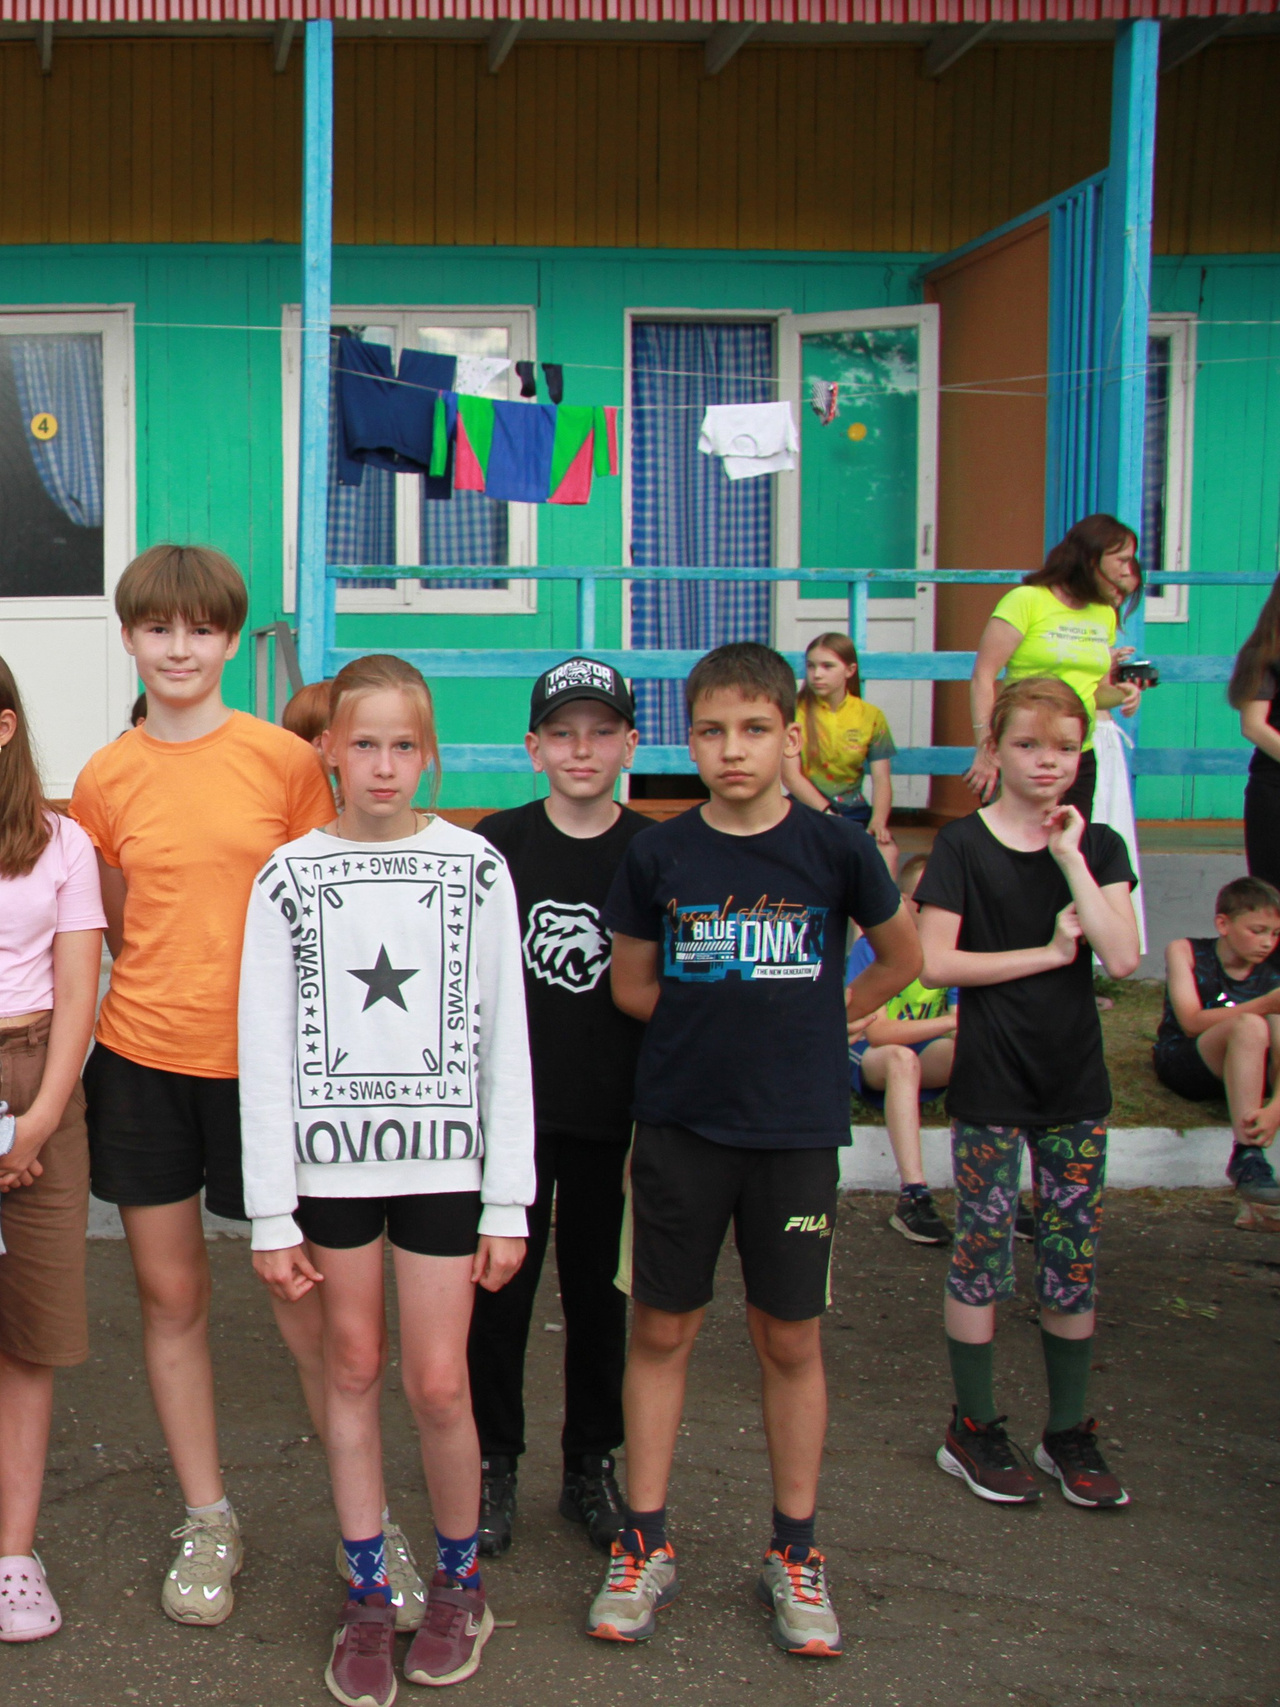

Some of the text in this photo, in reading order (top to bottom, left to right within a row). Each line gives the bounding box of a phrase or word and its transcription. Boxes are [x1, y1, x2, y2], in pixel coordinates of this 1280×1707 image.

[37, 418, 49, 433] 4
[548, 676, 612, 695] HOCKEY
[370, 857, 417, 875] SWAG
[736, 894, 811, 934] Active
[693, 921, 736, 941] BLUE
[300, 926, 320, 999] SWAG
[756, 967, 812, 976] THE NEW GENERATION
[447, 884, 467, 1075] 2 SWAG 4 U
[302, 1023, 321, 1037] 4
[303, 1061, 323, 1076] U
[324, 1080, 447, 1100] 2 SWAG 4 U
[784, 1213, 827, 1232] FILA
